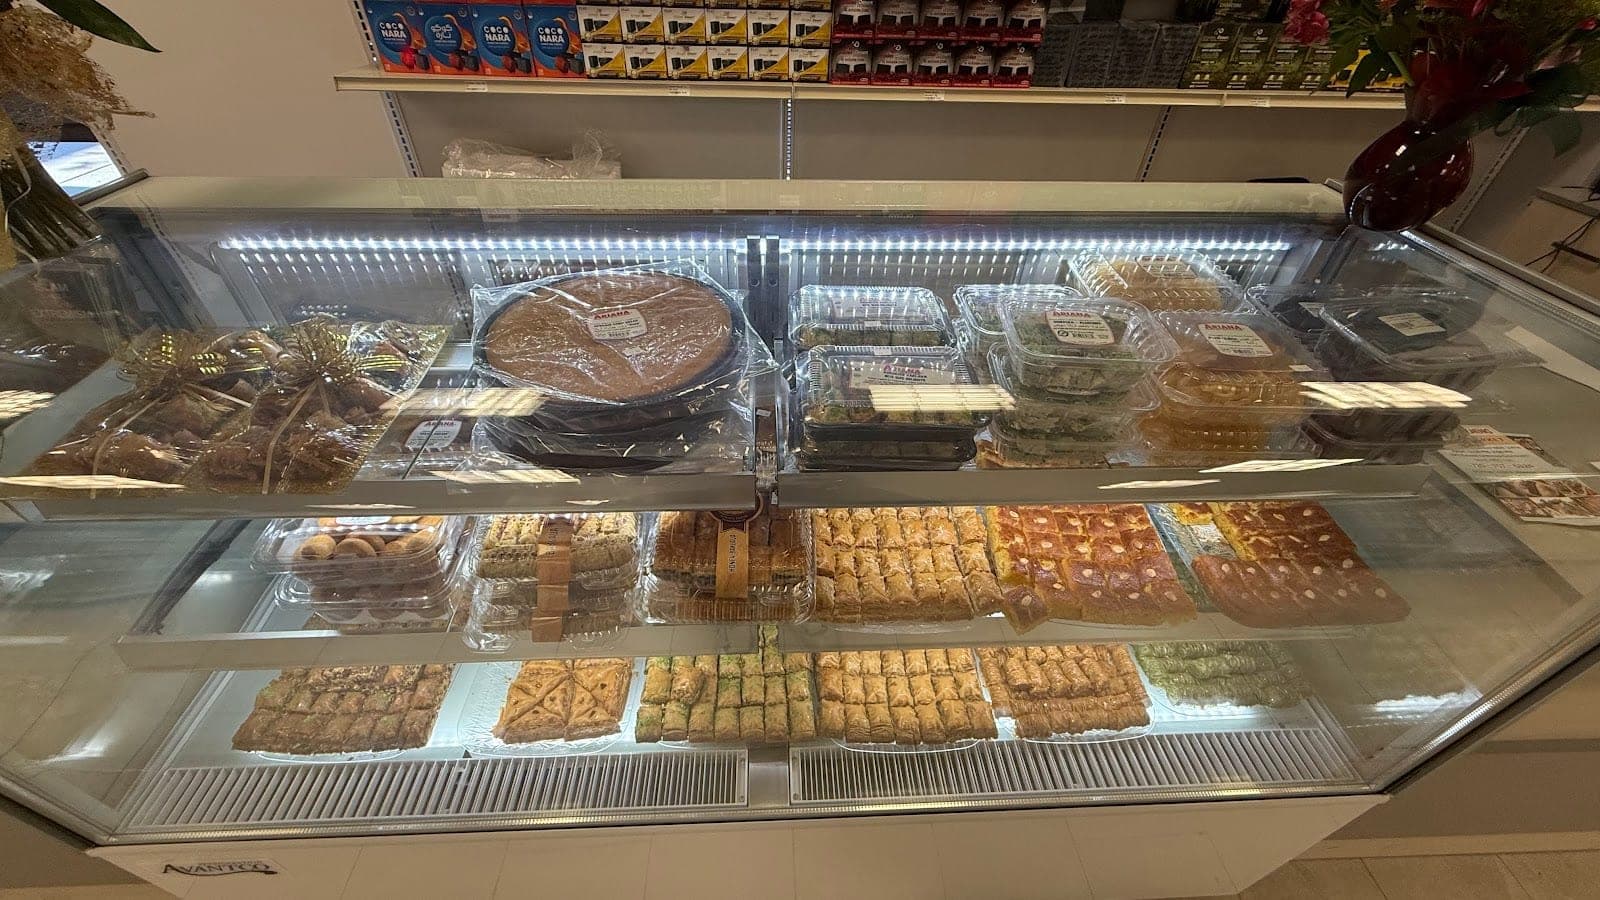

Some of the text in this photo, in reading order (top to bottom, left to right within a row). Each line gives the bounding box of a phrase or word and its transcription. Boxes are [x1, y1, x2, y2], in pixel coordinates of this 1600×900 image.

[379, 22, 404, 30] COCO
[483, 26, 509, 34] COCO
[381, 29, 407, 38] NARA
[537, 27, 563, 35] COCO
[485, 33, 511, 42] NARA
[539, 34, 565, 43] NARA
[594, 310, 630, 320] ARIANA
[1204, 323, 1242, 331] ARIANA
[162, 863, 272, 875] AVANTCO
